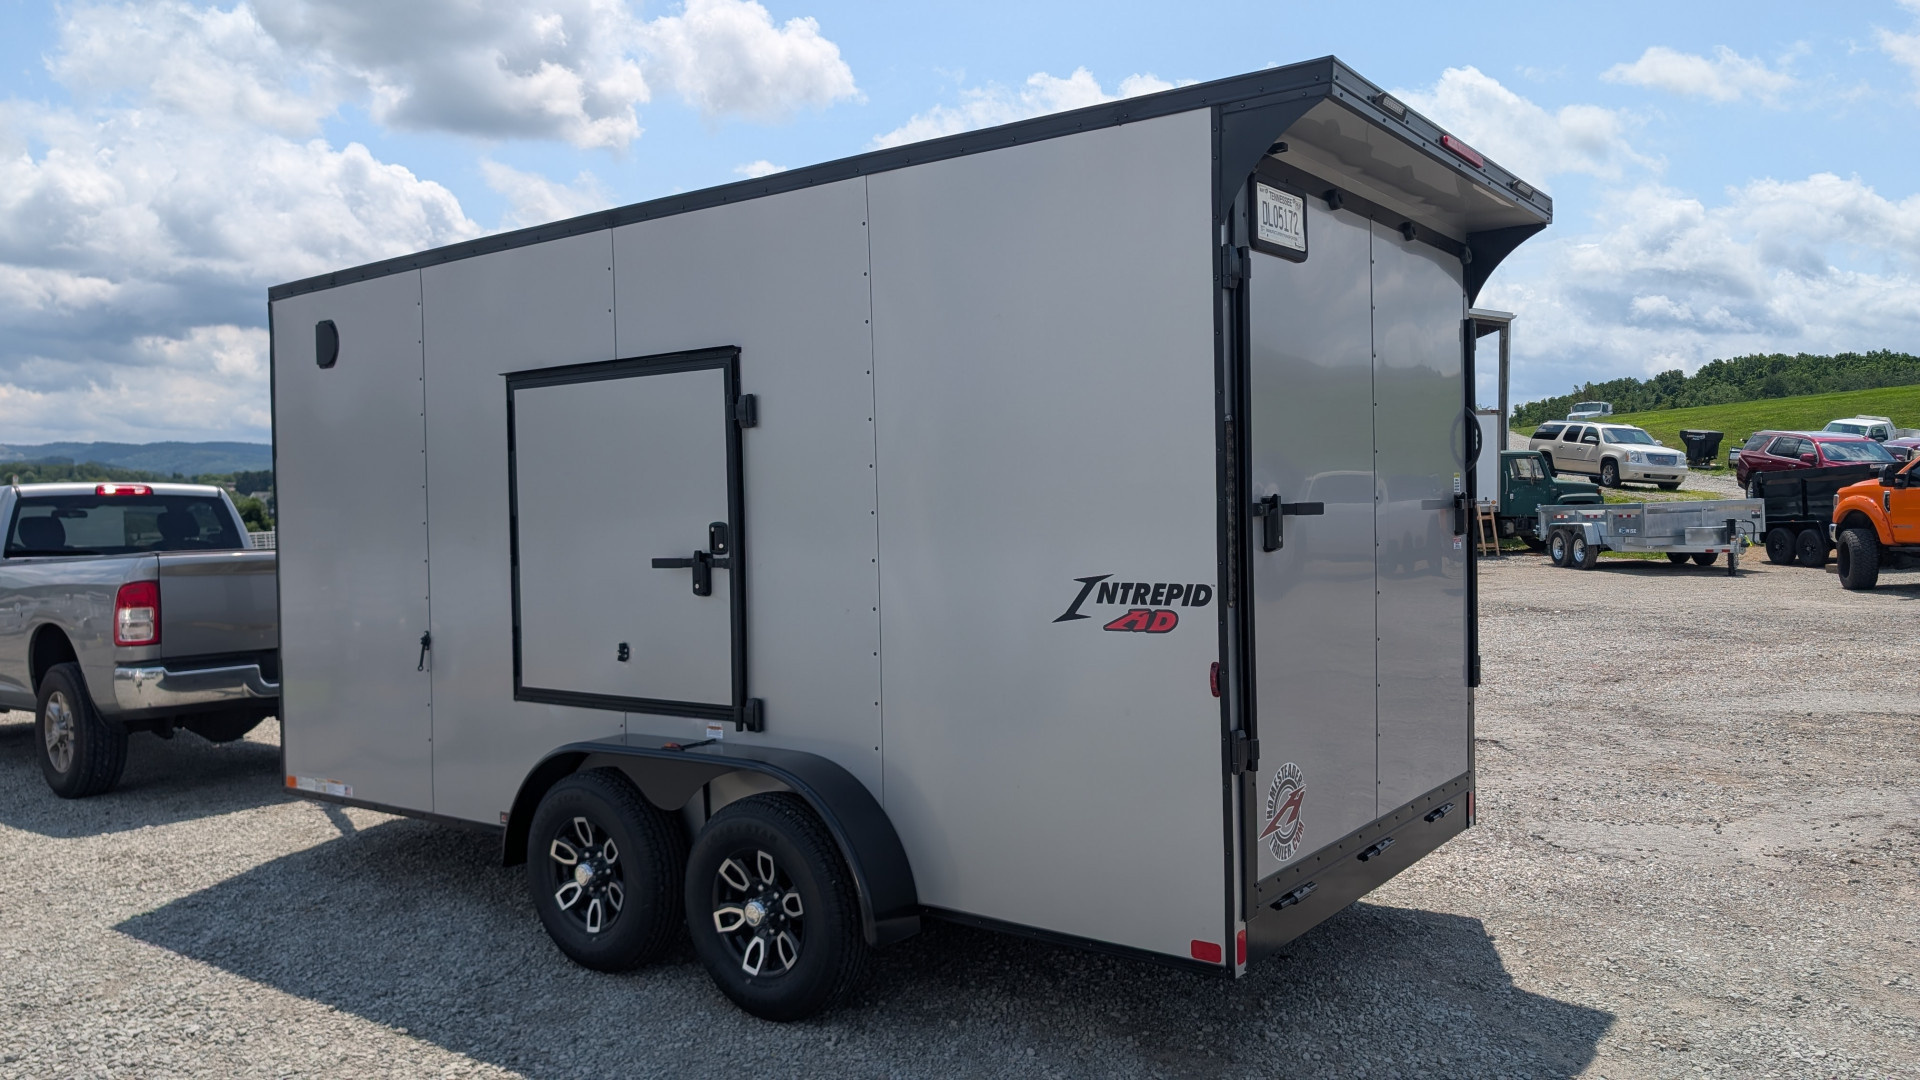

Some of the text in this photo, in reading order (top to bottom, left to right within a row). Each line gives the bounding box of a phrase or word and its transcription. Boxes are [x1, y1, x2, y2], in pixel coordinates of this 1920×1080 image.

[1269, 191, 1293, 207] TENNESSEE
[1262, 201, 1300, 236] DL05172
[1266, 763, 1303, 819] HOMESTEADER
